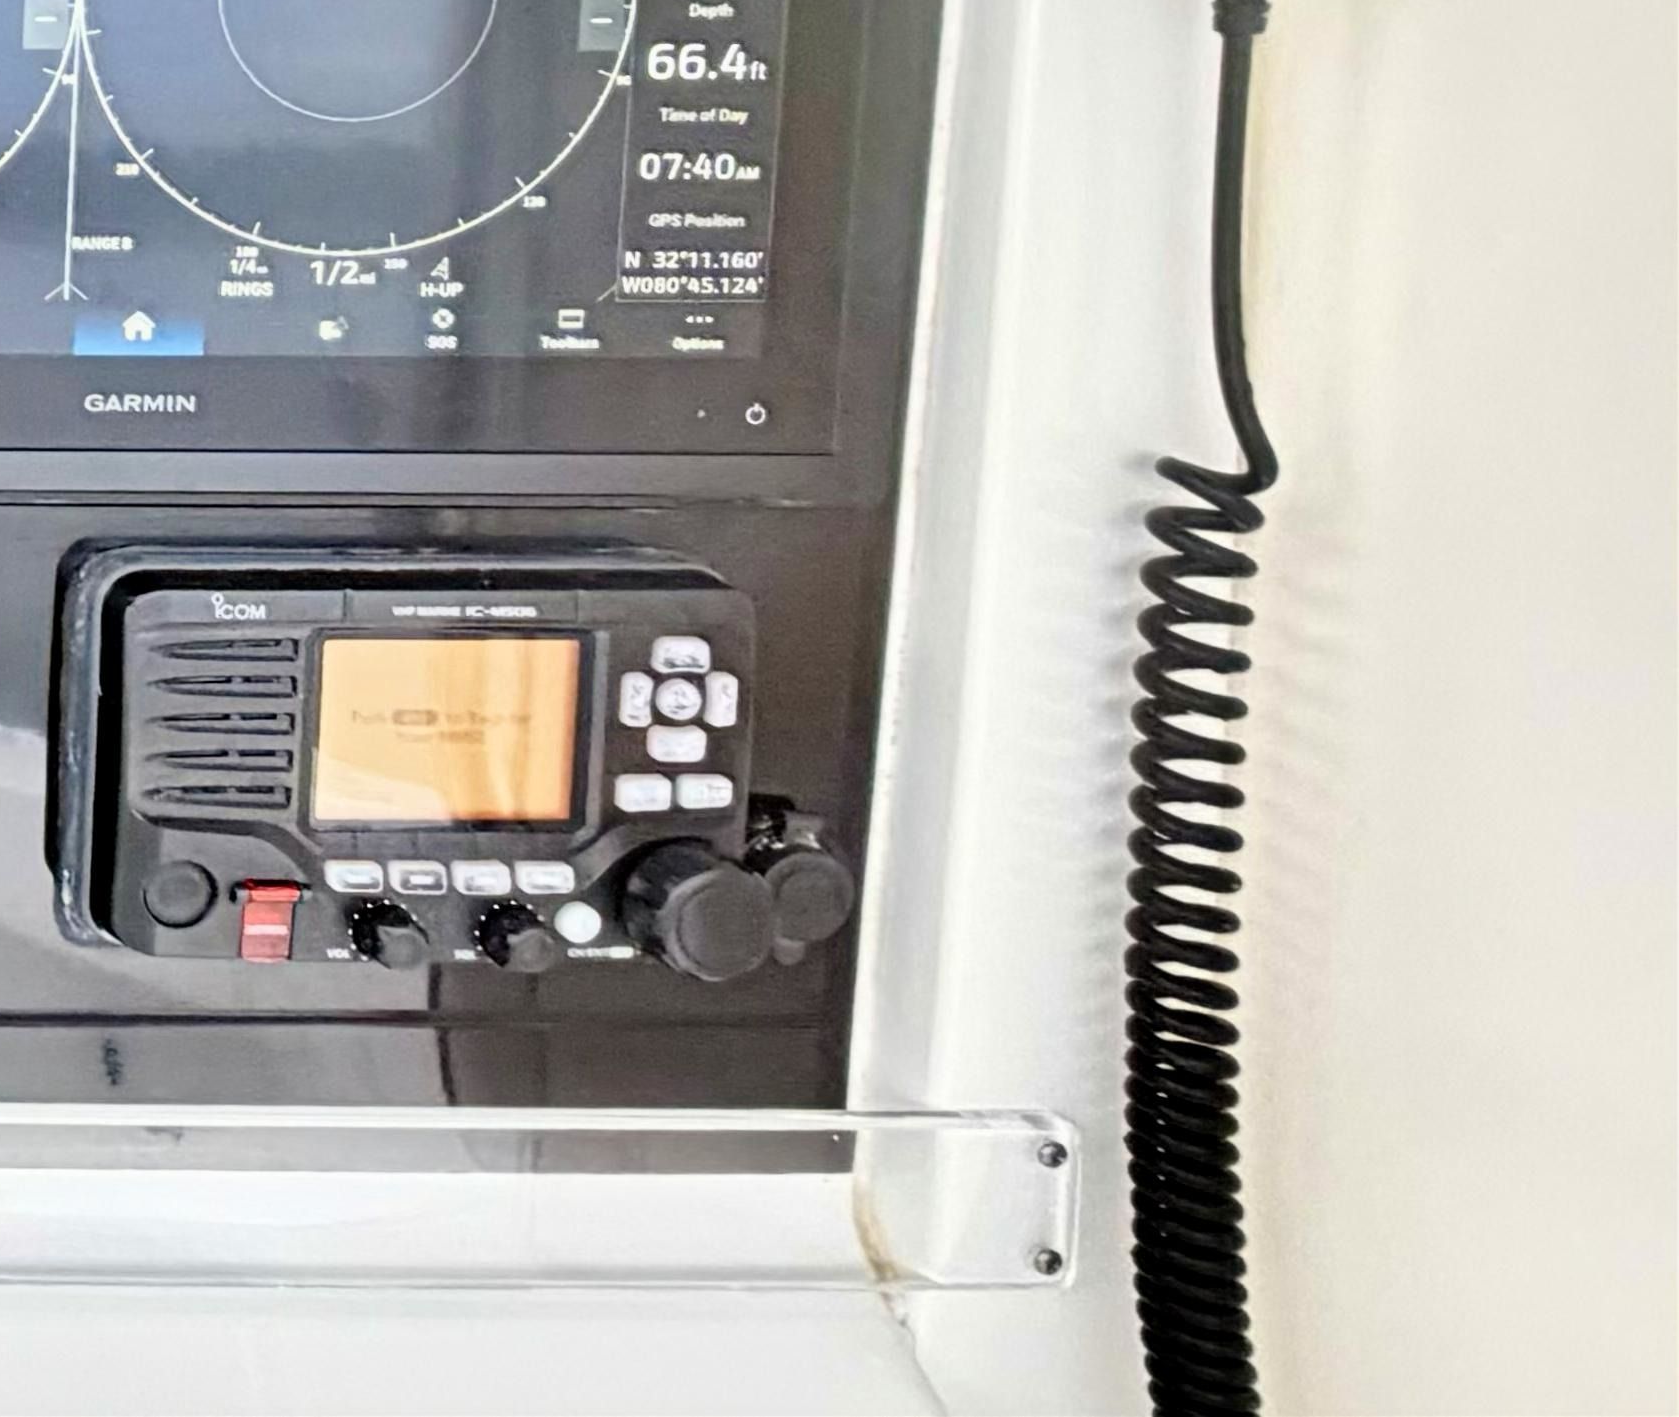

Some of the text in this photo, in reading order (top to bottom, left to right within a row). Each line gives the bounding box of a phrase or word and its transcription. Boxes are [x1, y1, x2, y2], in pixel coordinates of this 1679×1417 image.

[688, 2, 735, 21] Depth
[658, 107, 750, 126] Time of Day
[647, 212, 747, 228] GPS Position
[71, 236, 121, 251] RANGE
[624, 251, 642, 269] N
[220, 280, 274, 297] RINGS
[420, 282, 464, 298] H-UP
[425, 335, 458, 350] SOS
[672, 337, 725, 352] Options
[83, 393, 197, 414] GARMIN
